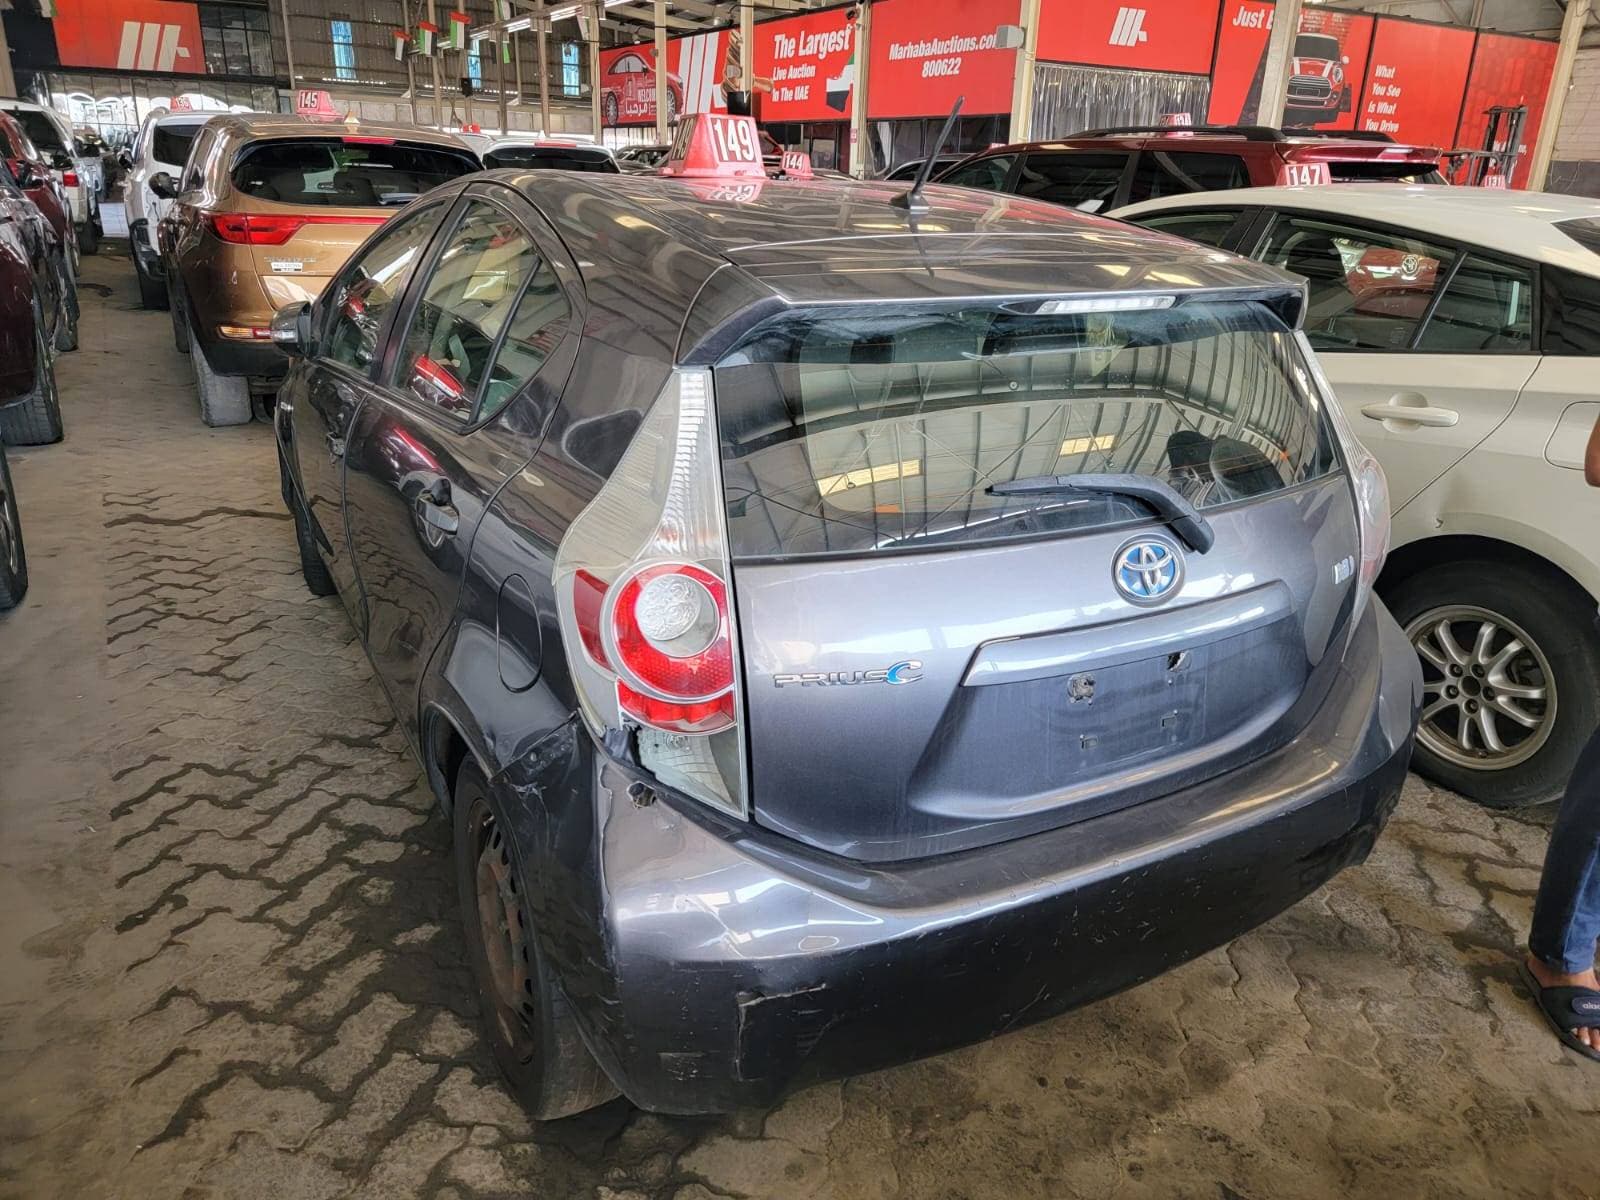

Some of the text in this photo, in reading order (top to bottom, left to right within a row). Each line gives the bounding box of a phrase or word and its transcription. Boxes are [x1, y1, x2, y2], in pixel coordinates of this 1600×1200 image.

[1232, 5, 1266, 29] Just
[773, 23, 853, 60] The Largest
[772, 63, 817, 81] Live Auction
[921, 57, 962, 78] 800622
[1374, 64, 1396, 79] What
[771, 85, 811, 103] In The UAE
[1371, 82, 1401, 98] You See
[300, 91, 318, 109] 145
[1367, 100, 1397, 116] Is What
[1364, 118, 1400, 133] You Drive
[713, 118, 755, 161] 149
[785, 153, 803, 170] 144
[1289, 165, 1321, 185] 147
